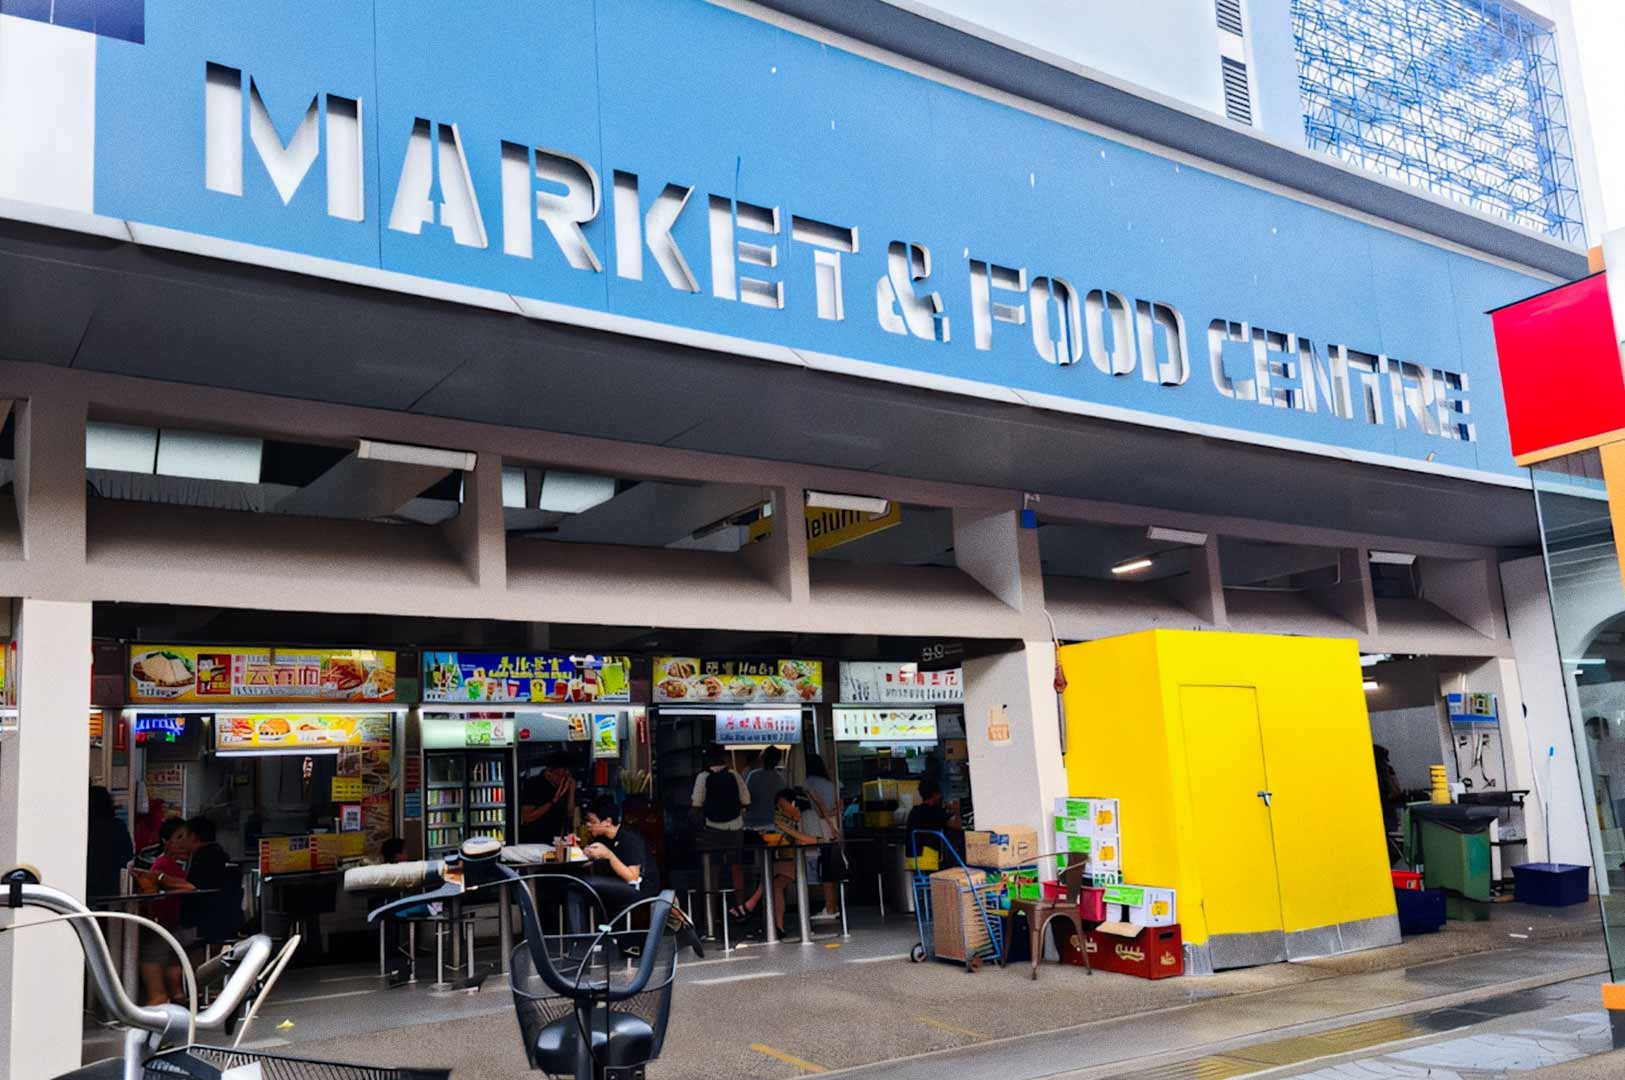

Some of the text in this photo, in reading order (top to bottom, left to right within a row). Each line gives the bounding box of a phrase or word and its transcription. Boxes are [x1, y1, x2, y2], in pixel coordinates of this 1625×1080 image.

[206, 61, 1477, 442] MARKET & FOOD CENTRE
